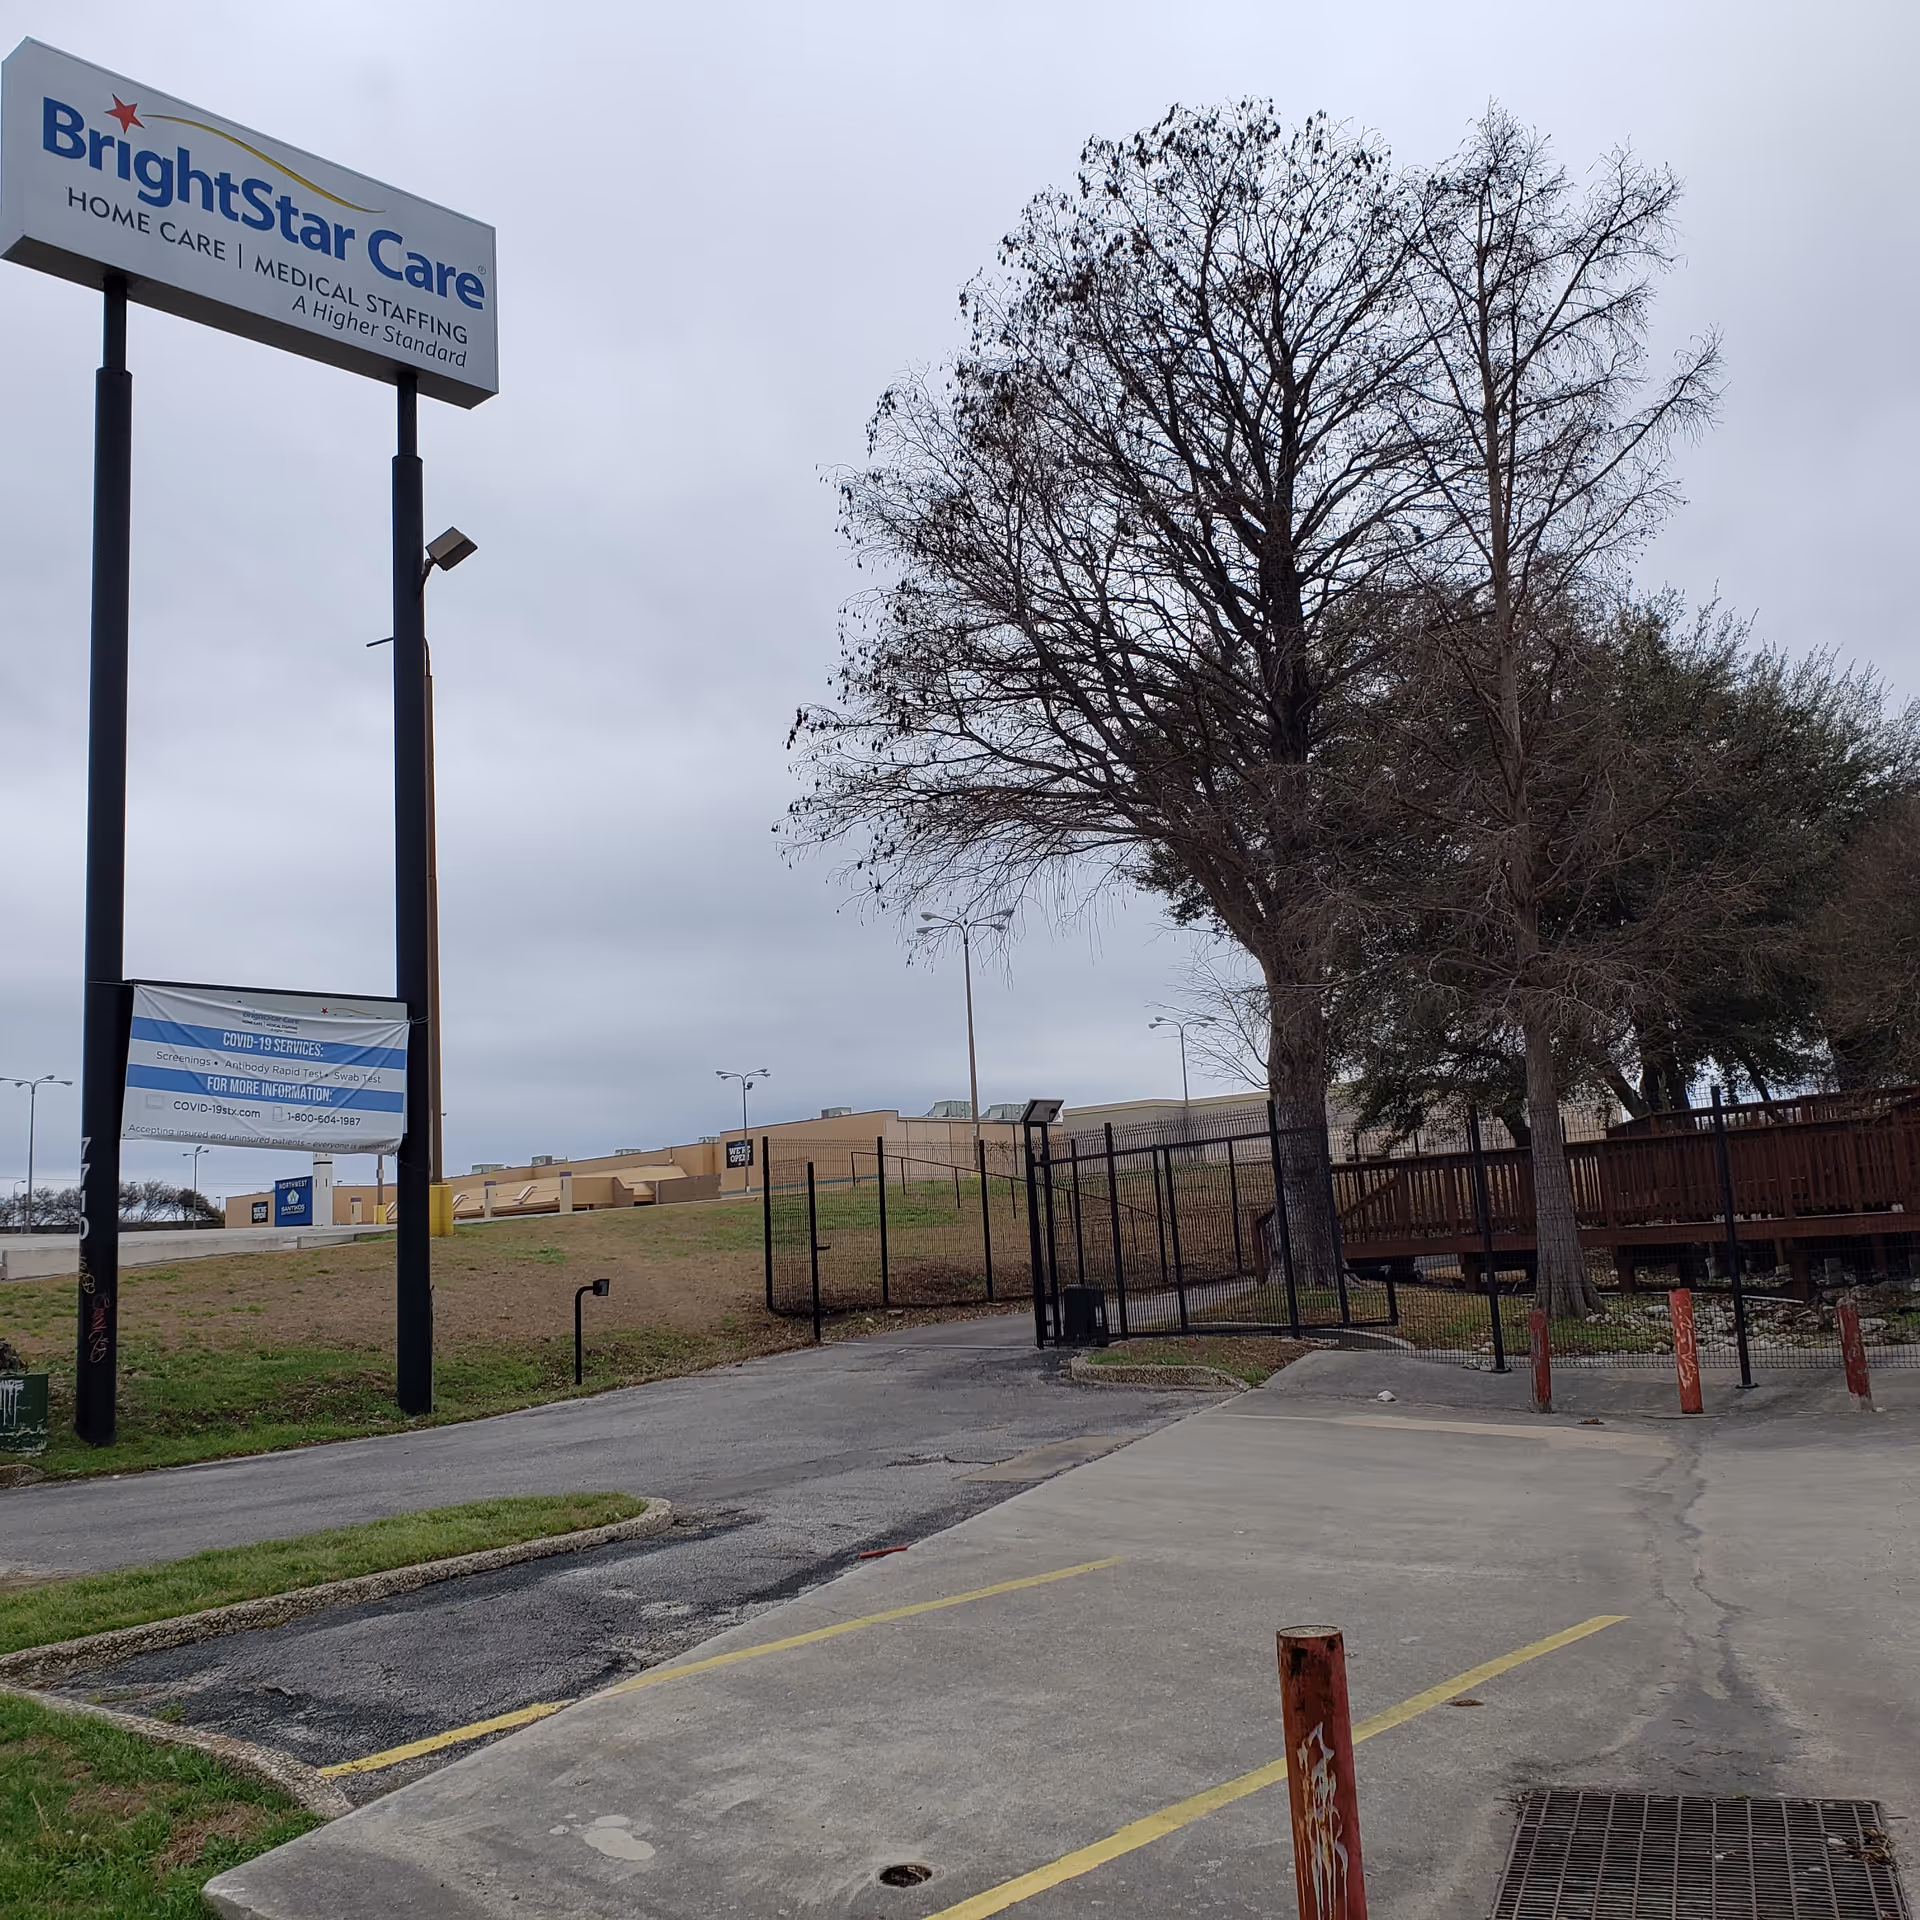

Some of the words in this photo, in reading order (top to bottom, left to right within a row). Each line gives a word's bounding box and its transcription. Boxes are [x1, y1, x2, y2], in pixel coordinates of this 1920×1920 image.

[43, 96, 355, 260] BrightStar
[367, 229, 486, 311] Care
[67, 186, 151, 235] HOME
[159, 221, 226, 262] CARE
[254, 255, 360, 308] MEDICAL
[366, 294, 468, 345] STAFFING
[292, 295, 306, 314] A
[313, 301, 379, 337] Higher
[382, 325, 467, 368] Standard
[223, 1032, 271, 1051] COVID-19
[274, 1039, 324, 1057] SERVICES:
[156, 1051, 211, 1066] Screenings
[225, 1060, 269, 1075] Antibody
[272, 1065, 300, 1077] Rapid
[303, 1069, 322, 1079] Test
[334, 1072, 359, 1082] Swab
[362, 1074, 381, 1084] Test
[207, 1076, 227, 1093] FOR
[230, 1079, 260, 1095] MORE
[262, 1082, 333, 1102] INFORMATION:
[287, 1112, 361, 1127] 1-800-604-1987
[128, 1124, 174, 1136] Accepting
[177, 1129, 208, 1139] insured
[211, 1131, 226, 1140] and
[229, 1133, 270, 1144] uninsured
[272, 1138, 304, 1147] patients
[312, 1141, 351, 1151] everyone
